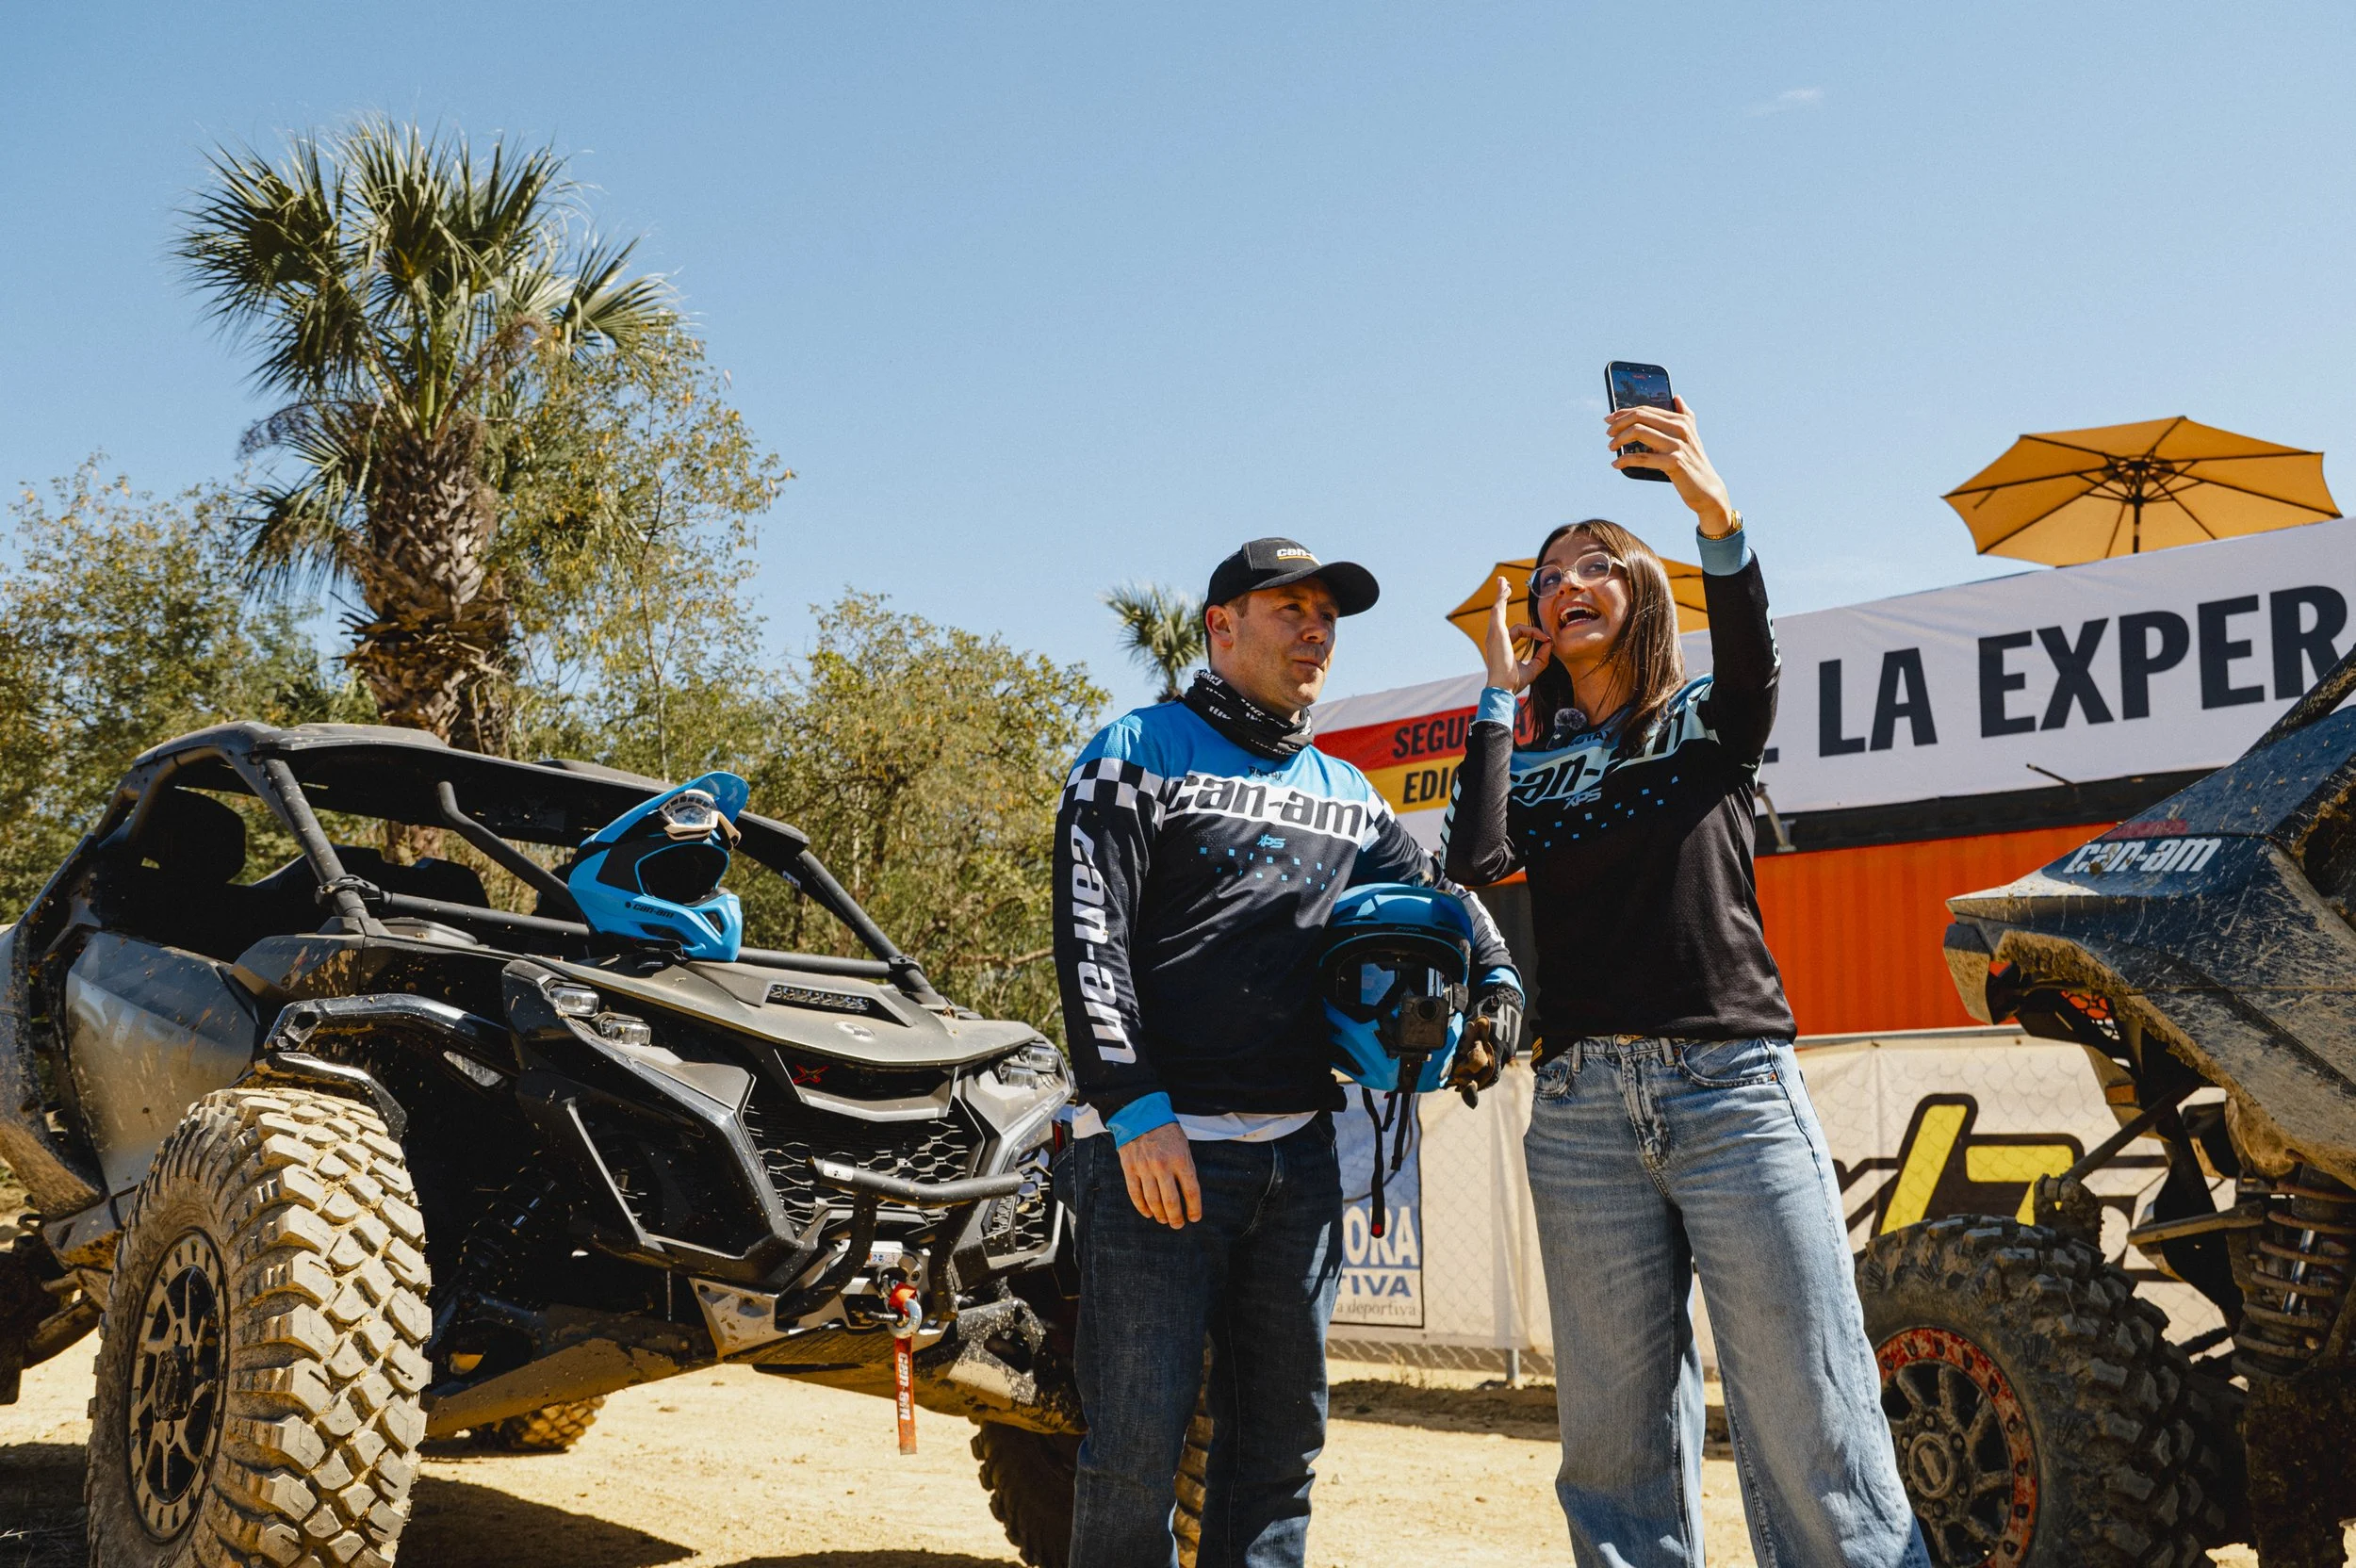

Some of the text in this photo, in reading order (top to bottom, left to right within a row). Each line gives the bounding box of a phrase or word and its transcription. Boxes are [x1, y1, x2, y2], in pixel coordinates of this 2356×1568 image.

[1277, 548, 1321, 565] can-
[1819, 585, 2348, 757] LA EXPER
[1393, 707, 1527, 760] SEGUA
[1166, 774, 1364, 839] can-am
[1403, 767, 1458, 804] EDI
[2063, 838, 2221, 874] can-am
[1071, 824, 1137, 1064] can-am
[1348, 1299, 1415, 1318] deportiva
[898, 1351, 910, 1421] can-am
